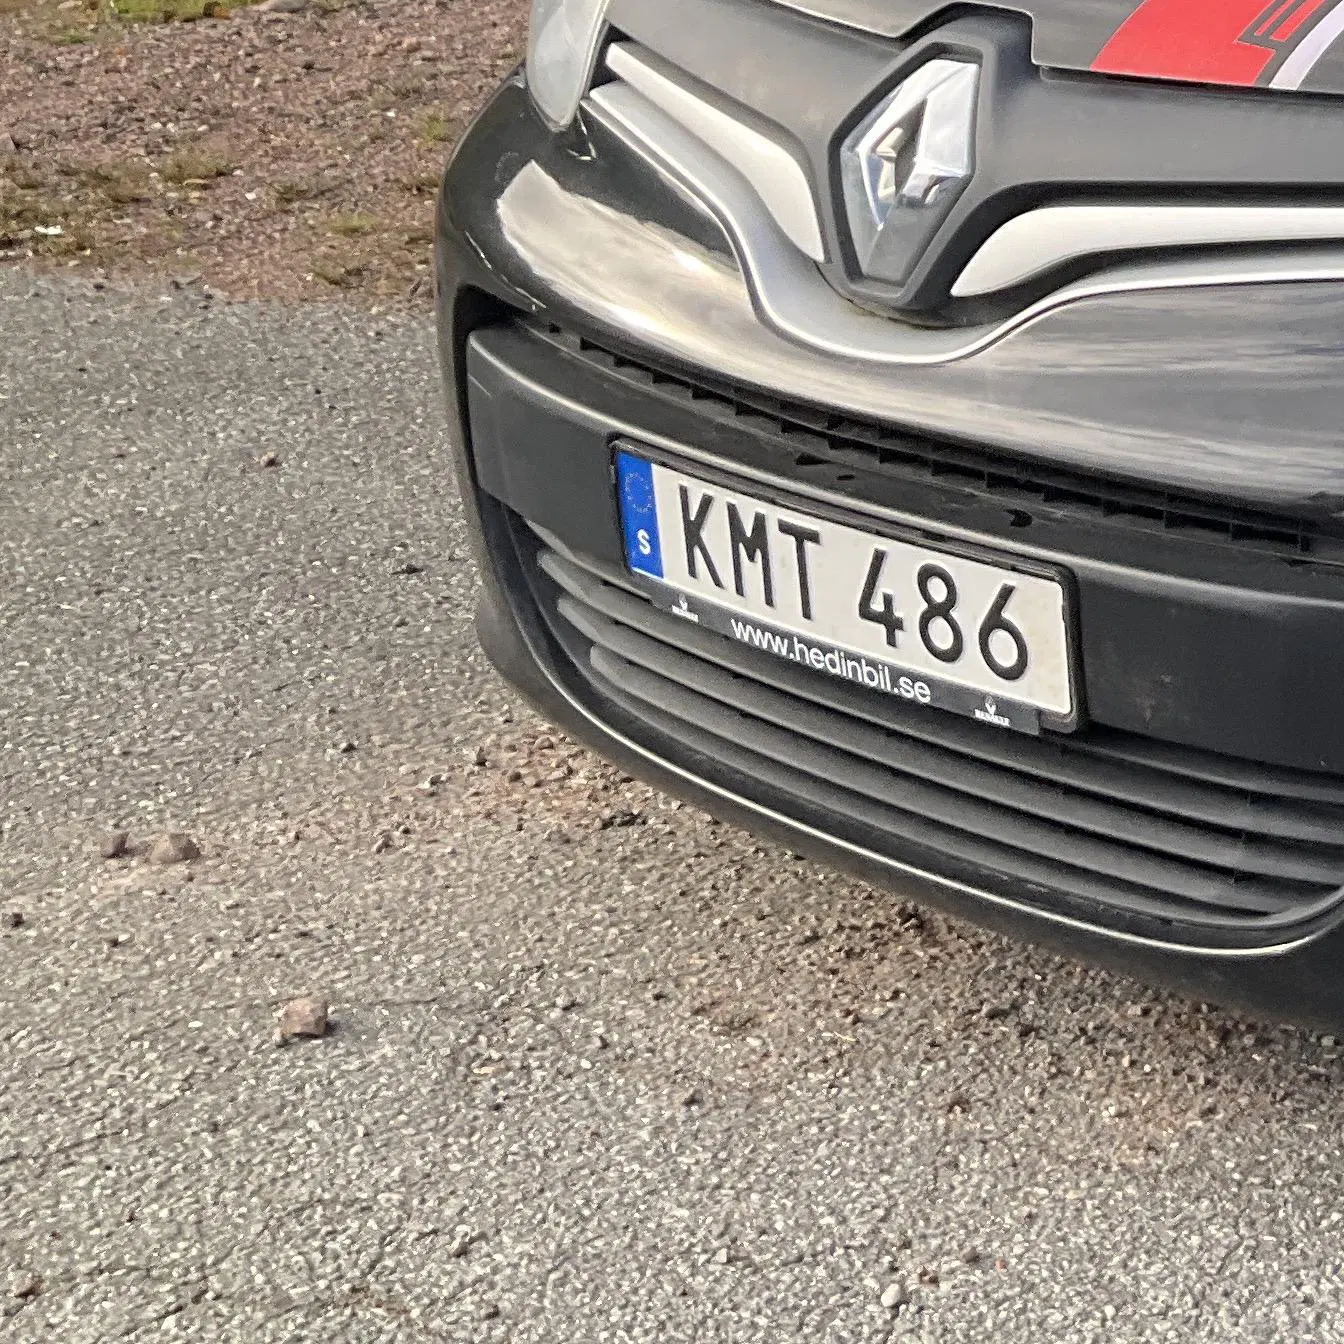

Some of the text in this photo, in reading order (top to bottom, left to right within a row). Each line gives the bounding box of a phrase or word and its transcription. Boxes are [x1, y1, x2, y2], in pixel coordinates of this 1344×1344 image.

[637, 527, 652, 556] S
[678, 483, 1029, 682] KMT 486
[730, 618, 931, 704] www.hedinbil.se
